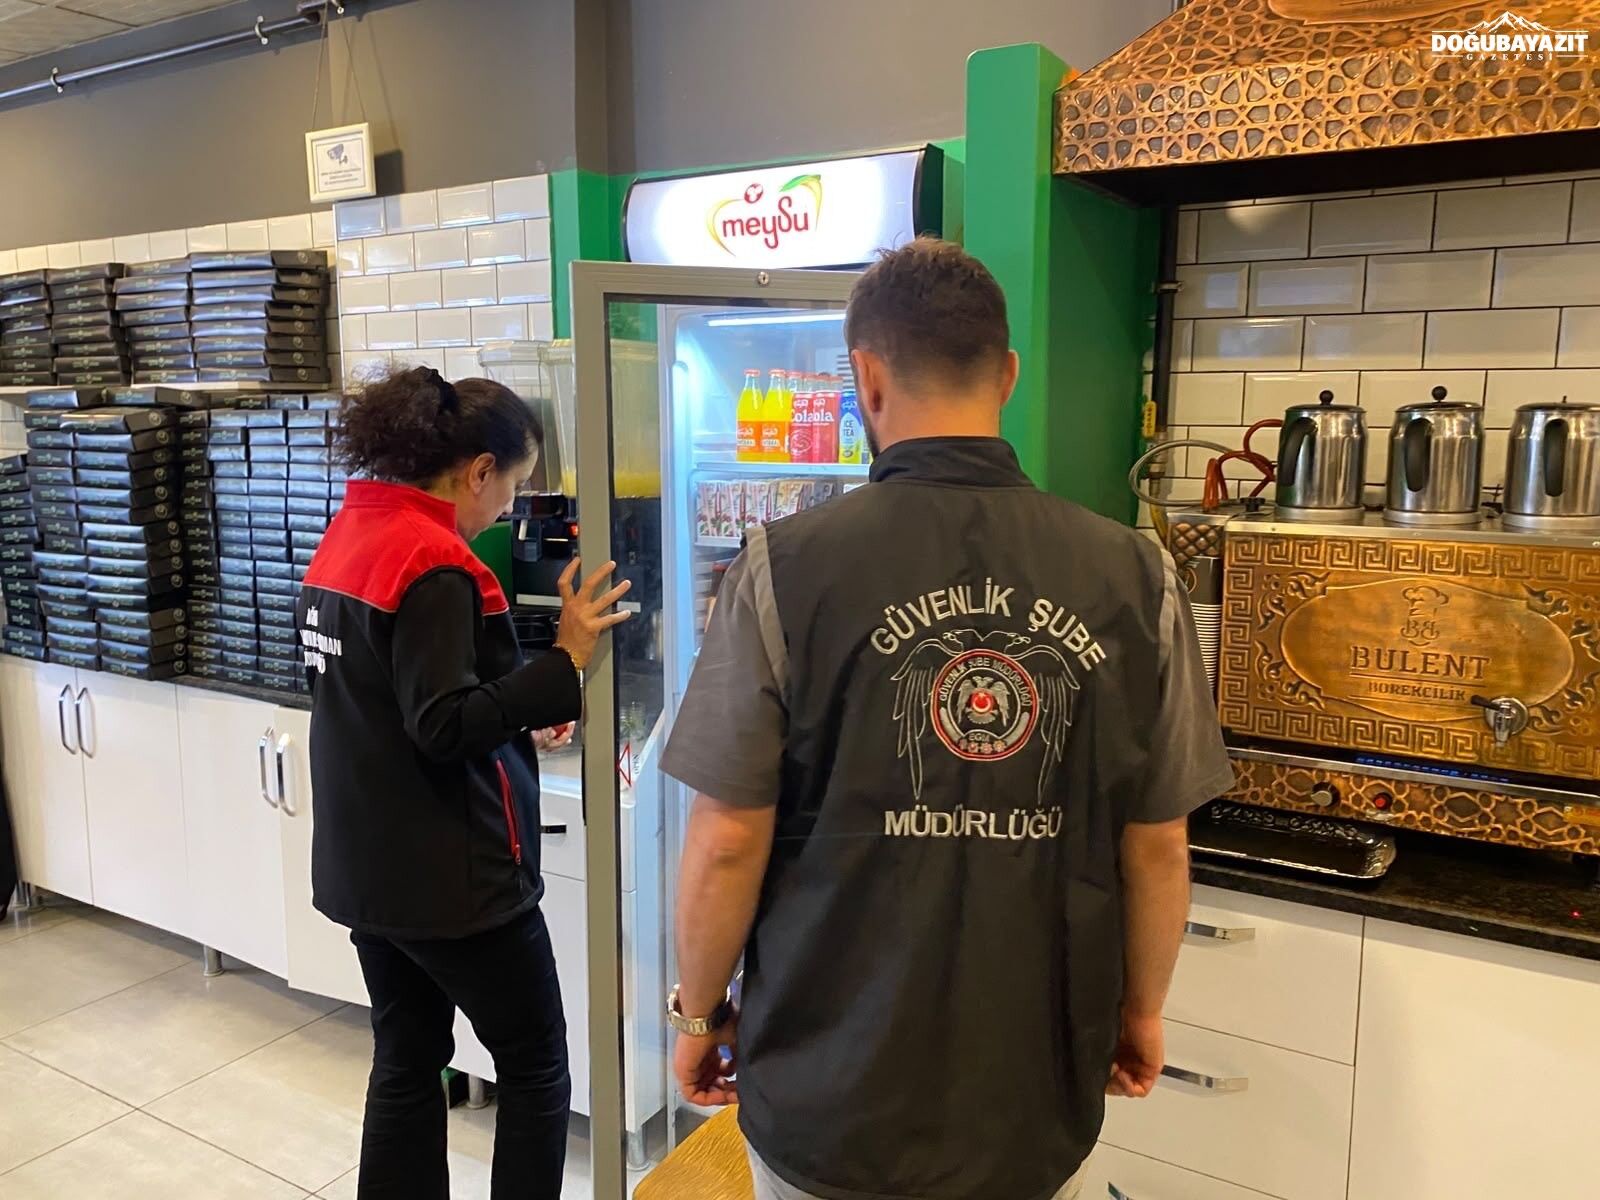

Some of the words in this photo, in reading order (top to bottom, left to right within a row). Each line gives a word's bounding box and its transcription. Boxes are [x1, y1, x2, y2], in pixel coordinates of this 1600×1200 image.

[870, 577, 1015, 654] GÜVENLİK
[1028, 598, 1107, 671] ŞUBE
[884, 804, 1063, 840] MÜDÜRLÜĞÜ
